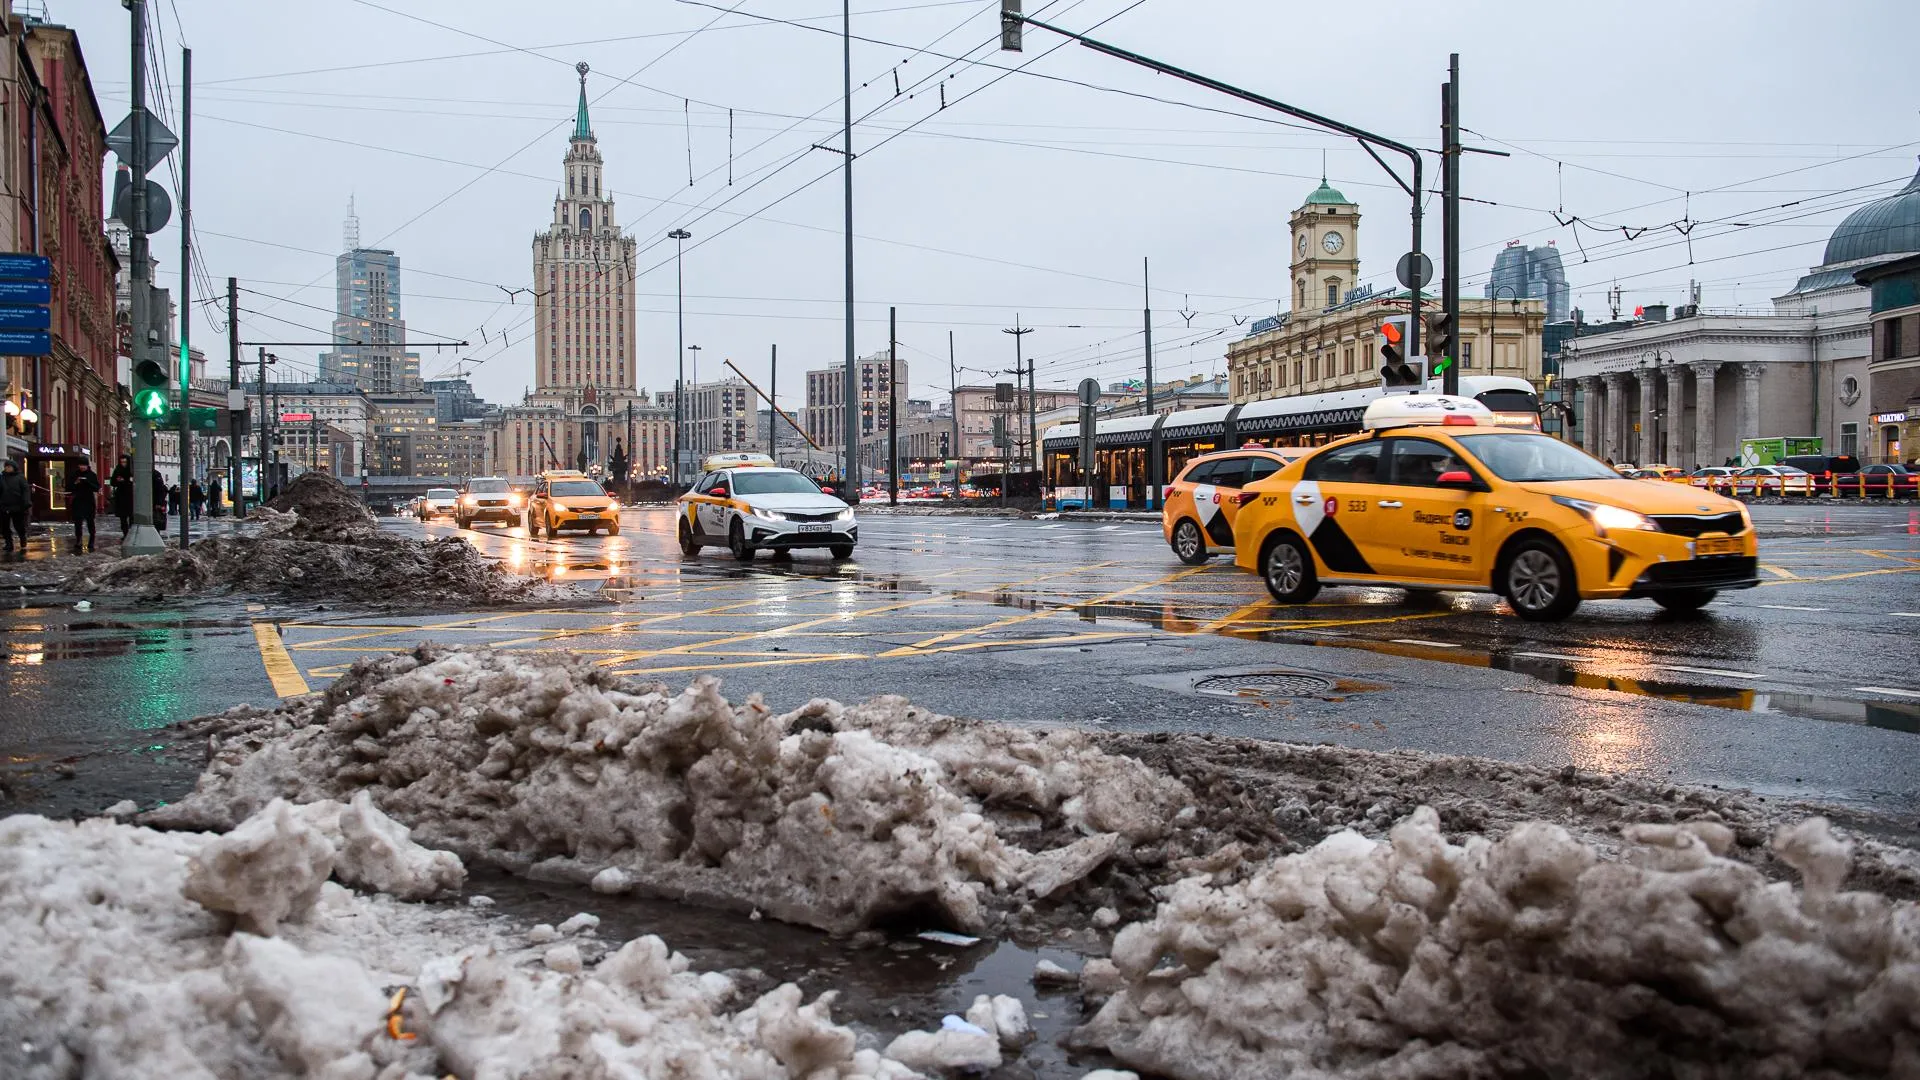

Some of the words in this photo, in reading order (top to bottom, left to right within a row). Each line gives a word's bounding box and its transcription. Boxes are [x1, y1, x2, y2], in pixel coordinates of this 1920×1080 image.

[1347, 500, 1367, 512] 533
[1413, 510, 1451, 525] Яндекс
[1438, 530, 1470, 545] Такси
